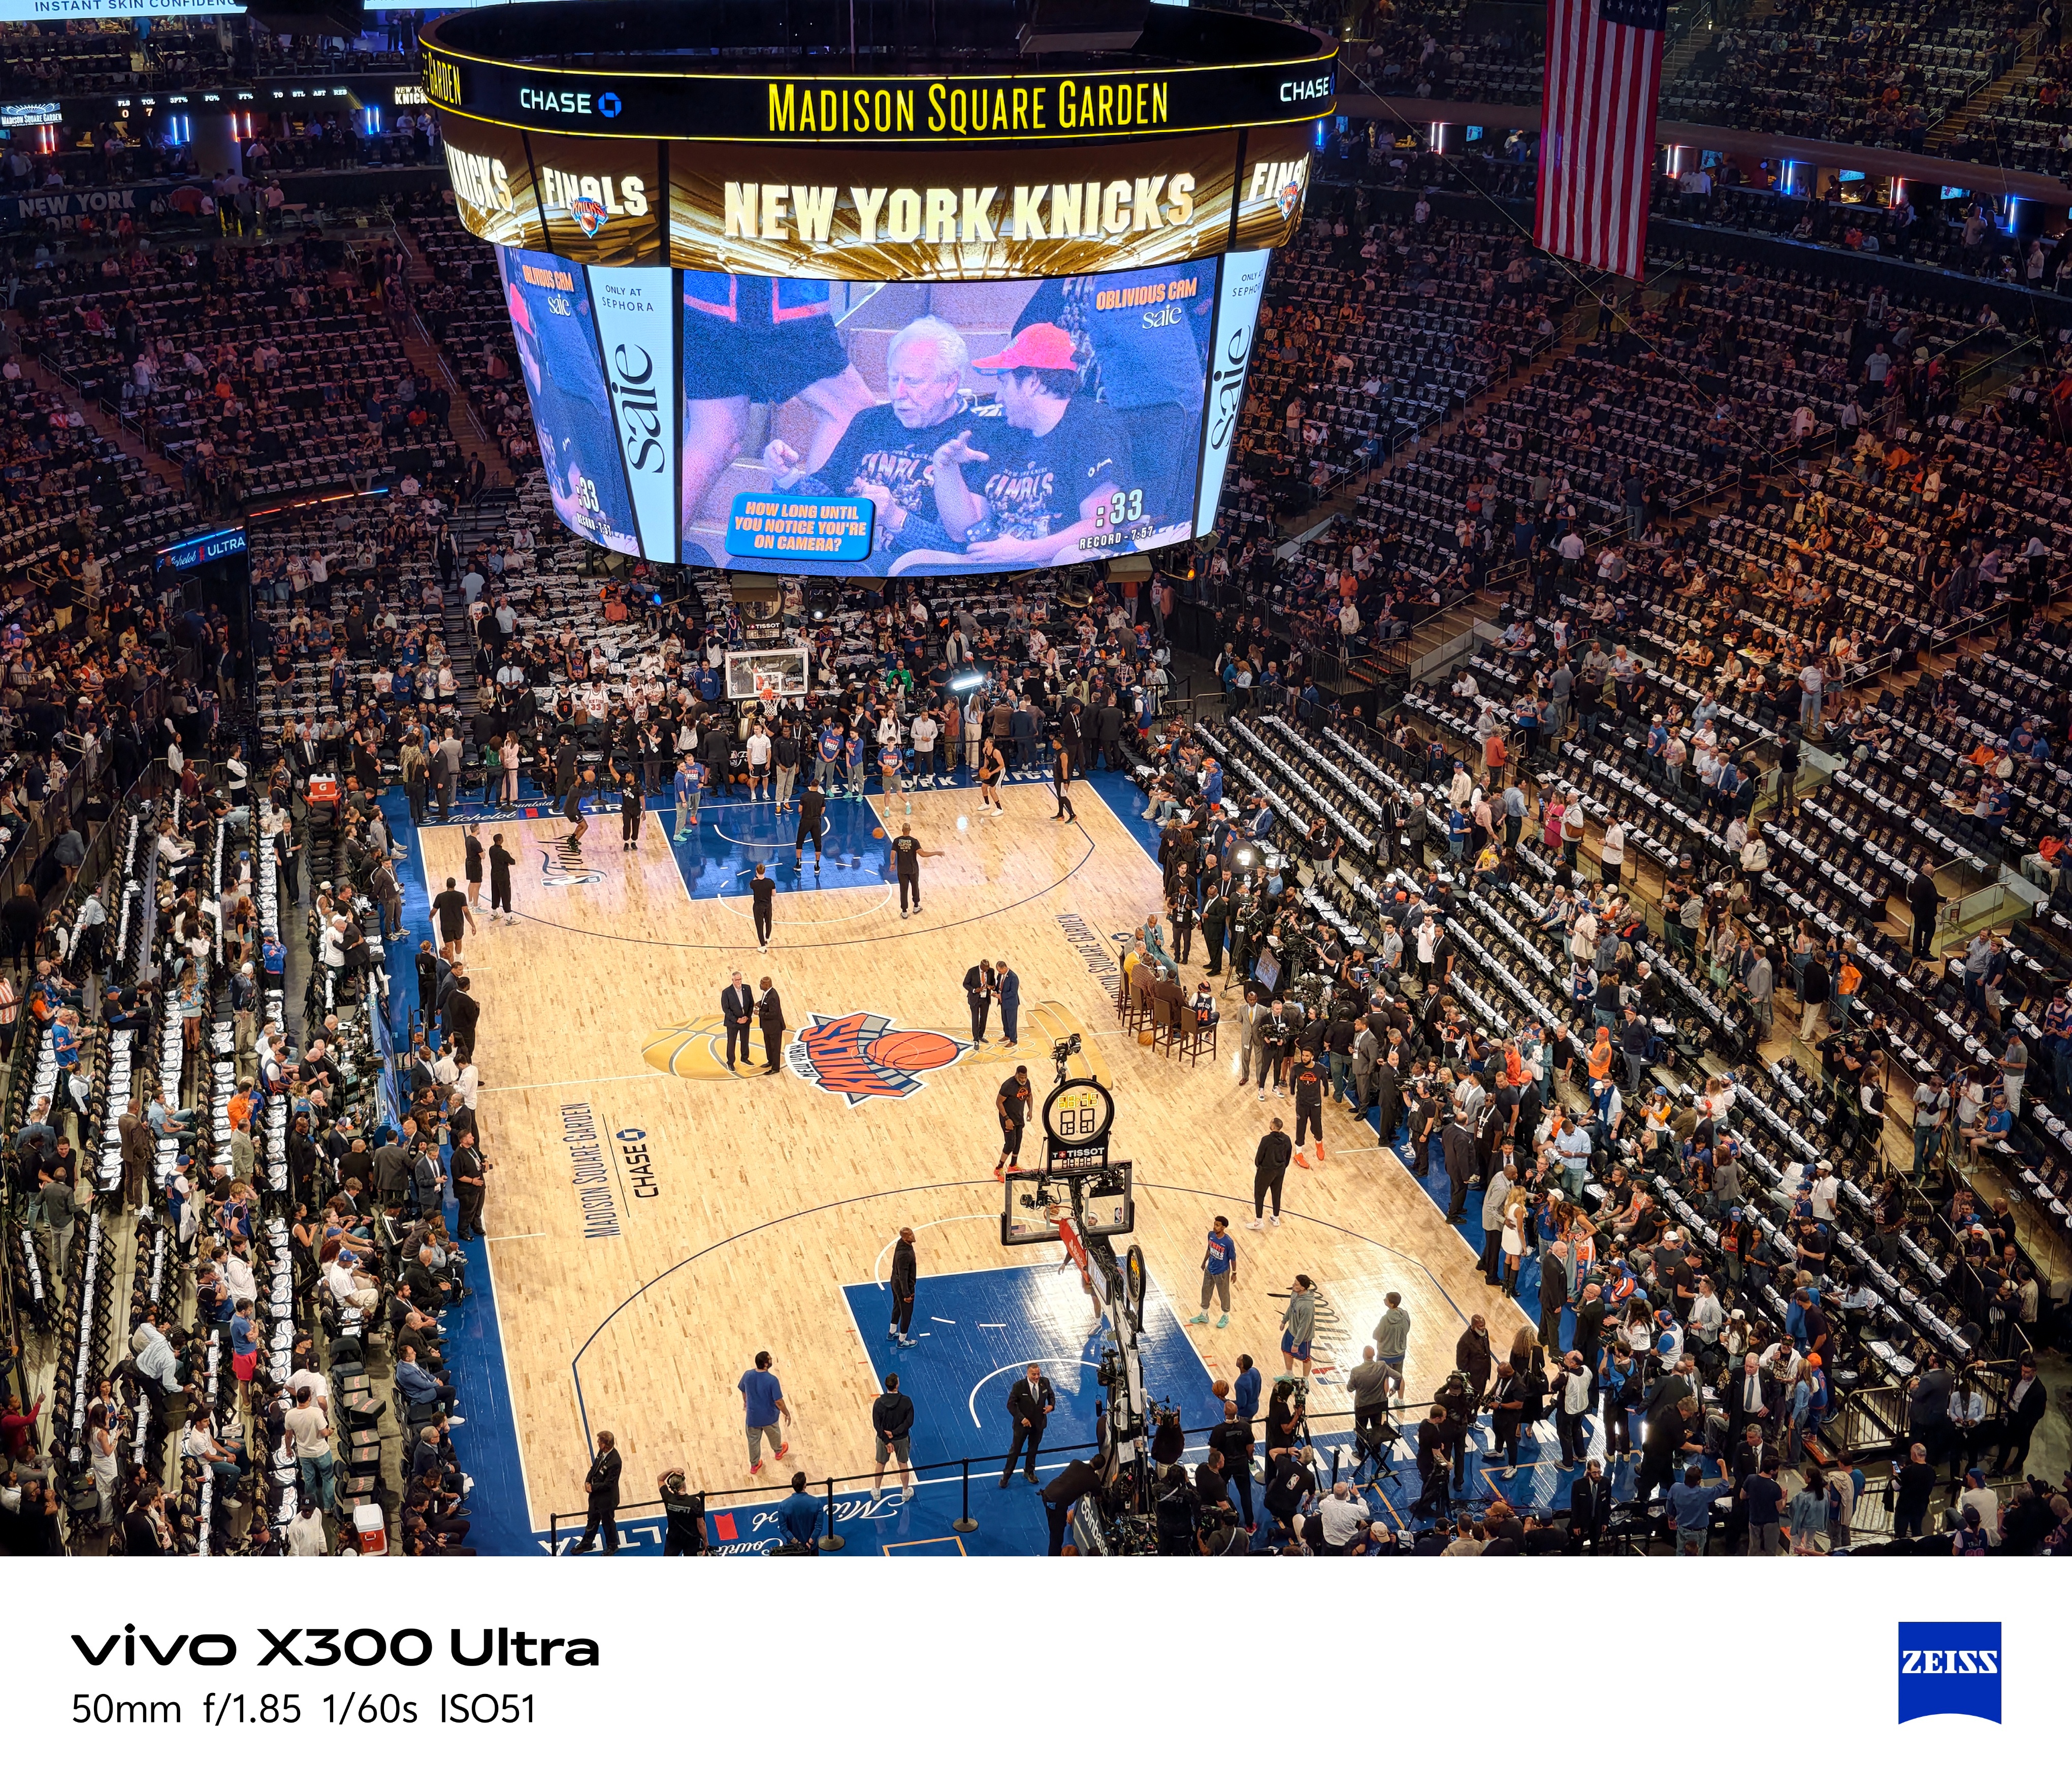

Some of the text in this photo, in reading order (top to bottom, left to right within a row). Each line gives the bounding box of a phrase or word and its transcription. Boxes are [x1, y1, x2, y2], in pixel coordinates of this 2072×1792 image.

[35, 0, 101, 12] INSTANT
[109, 0, 144, 9] SKIN
[428, 51, 461, 106] GARDEN
[1280, 76, 1330, 102] CHASE
[395, 93, 428, 105] KNICK
[520, 88, 592, 114] CHASE
[769, 80, 1168, 135] MADISON SQUARE GARDEN
[2, 116, 24, 125] MADISON
[146, 108, 153, 117] 7
[1248, 151, 1309, 202] FINA
[18, 190, 136, 218] NEW YORK
[542, 166, 649, 216] FINALS
[724, 172, 1195, 243] NEW YORK KNICKS
[1232, 281, 1262, 297] SEPHOR
[1241, 272, 1257, 281] ONLY
[605, 284, 642, 297] ONLY AT
[1096, 277, 1197, 311] OBLIVIOUS CAM
[602, 297, 654, 312] SEPHORA
[1142, 304, 1182, 330] saie
[1211, 325, 1251, 451] saie
[611, 343, 665, 473] saie
[575, 475, 599, 513] :33
[746, 501, 859, 520] HOW LONG UNTIL
[1096, 489, 1143, 527] :33
[576, 512, 595, 530] RECORD
[598, 522, 611, 536] 7:57
[735, 516, 866, 536] YOU NOTICE YOU'RE
[208, 536, 247, 557] ULTRA
[754, 534, 842, 552] ON CAMERA?
[1079, 532, 1121, 550] RECORD
[1131, 526, 1153, 540] 7:57
[901, 776, 958, 789] ORK
[502, 799, 554, 808] ourtsid
[548, 804, 623, 815] UTR
[1054, 913, 1096, 942] GARDEN
[1075, 943, 1117, 973] SQUARE
[1197, 1009, 1208, 1021] 14
[789, 1043, 819, 1078] NEW YORK
[801, 1013, 906, 1098] KNICKS
[1067, 1147, 1105, 1158] TISSOT
[560, 1102, 621, 1238] MADISON SQUARE GARDEN
[623, 1143, 659, 1198] CHASE
[537, 1525, 663, 1556] LTRA
